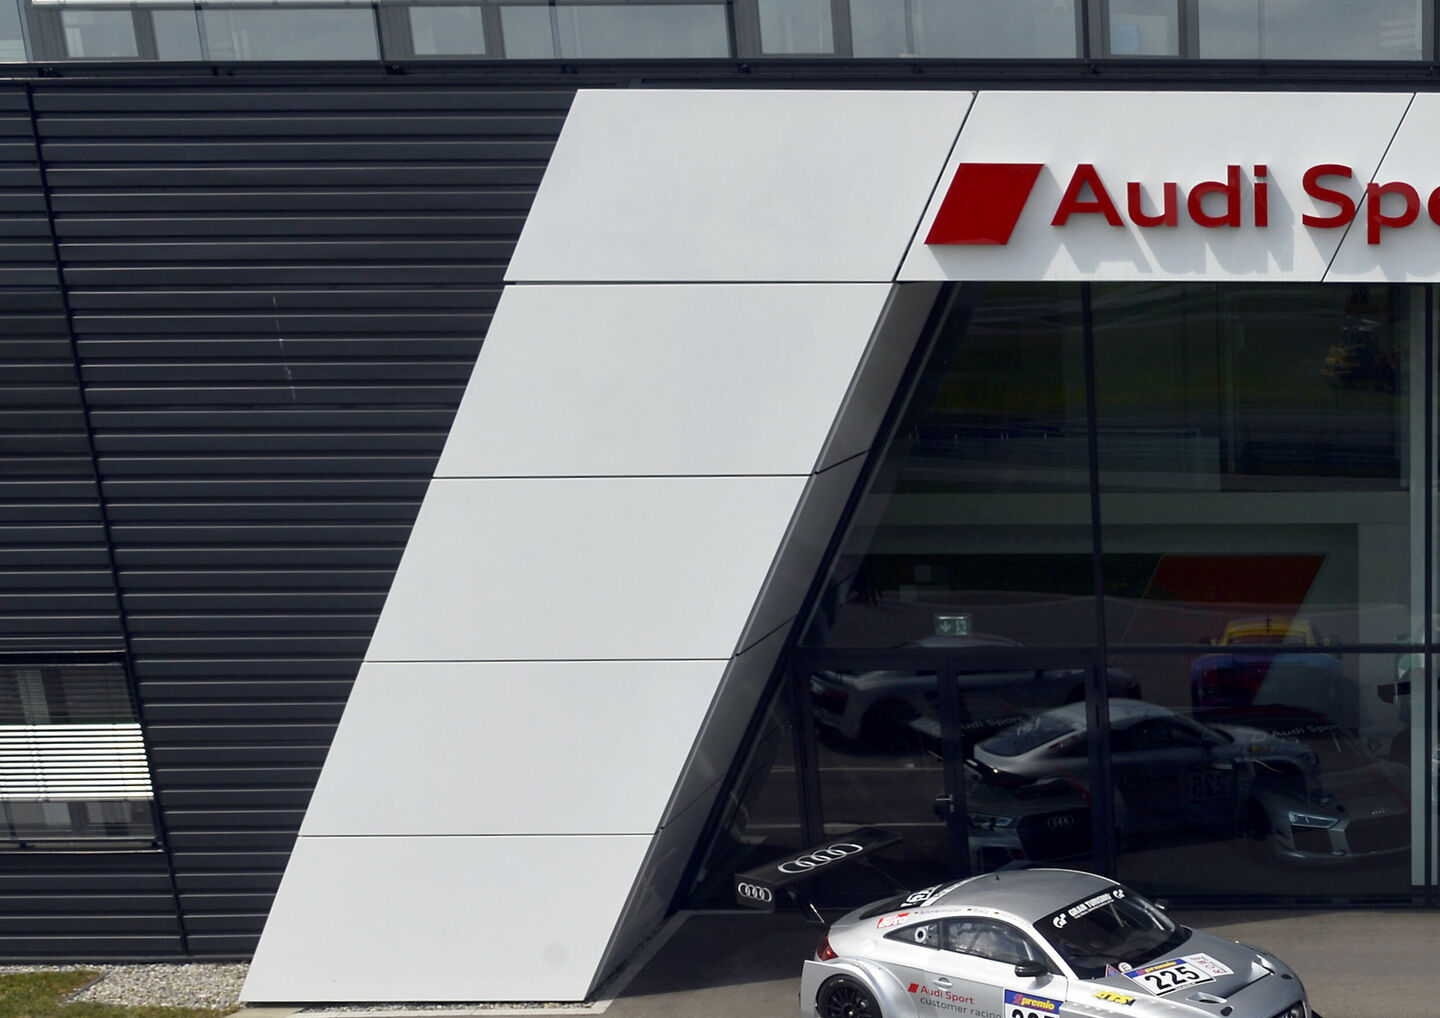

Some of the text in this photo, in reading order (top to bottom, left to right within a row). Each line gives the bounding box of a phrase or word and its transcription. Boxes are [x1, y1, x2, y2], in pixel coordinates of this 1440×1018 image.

[1051, 163, 1268, 230] Audi
[1144, 966, 1201, 991] 225
[921, 986, 975, 1005] Audi Sport
[1021, 997, 1056, 1012] premio
[920, 997, 968, 1014] customer
